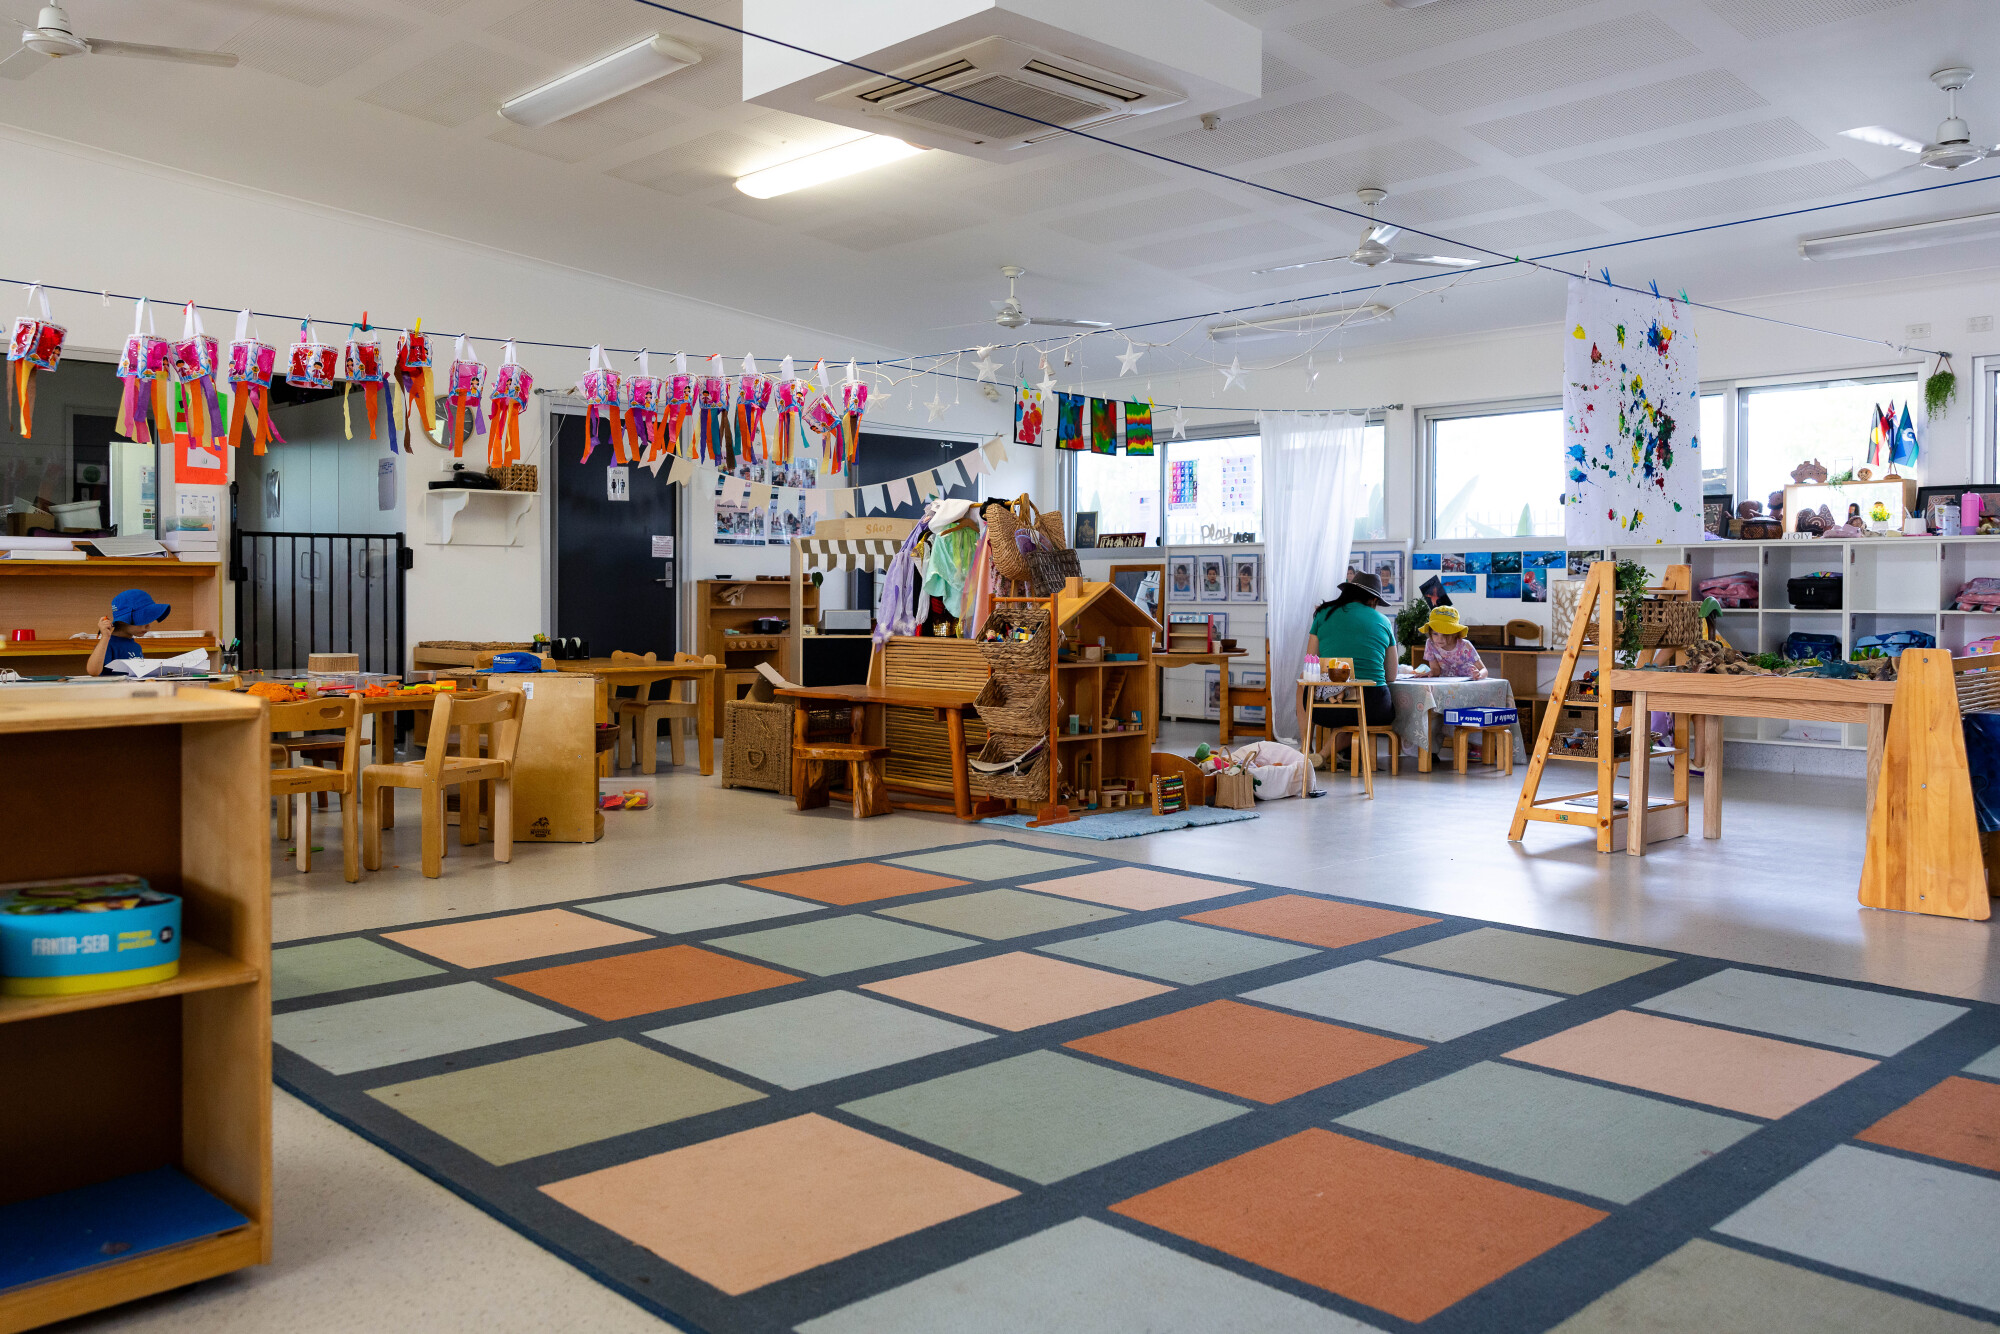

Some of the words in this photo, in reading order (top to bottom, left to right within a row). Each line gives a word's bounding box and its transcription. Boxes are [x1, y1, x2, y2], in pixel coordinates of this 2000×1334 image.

[1201, 523, 1232, 544] Play
[1499, 713, 1516, 722] Double
[31, 934, 109, 956] FANTA-SEA
